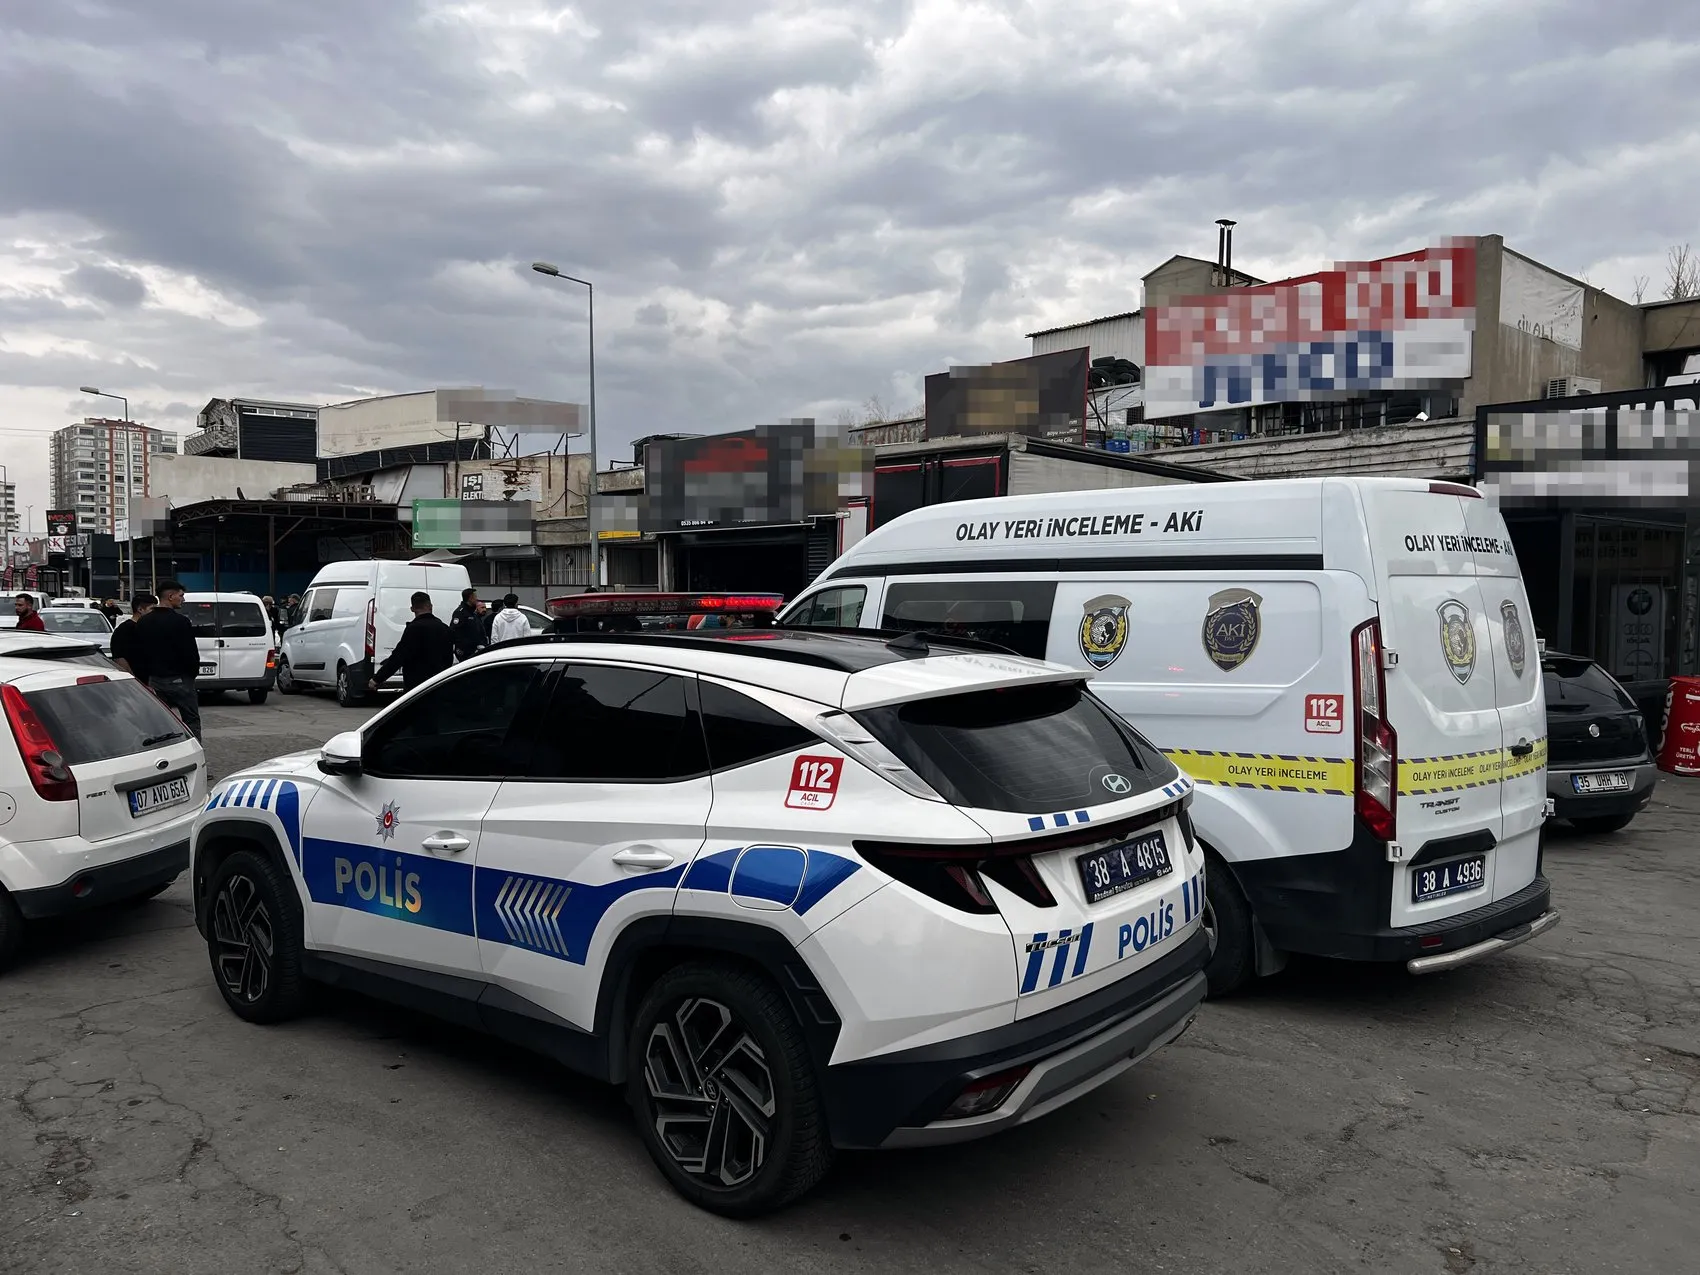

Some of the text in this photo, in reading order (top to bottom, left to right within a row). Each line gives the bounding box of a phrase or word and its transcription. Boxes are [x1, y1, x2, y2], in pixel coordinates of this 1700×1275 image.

[956, 521, 1000, 541] OLAY
[1004, 519, 1043, 538] YERİ
[1046, 513, 1144, 538] İNCELEME
[1163, 510, 1203, 533] AKİ
[1404, 534, 1436, 552] OLAY
[1437, 534, 1460, 552] YERİ
[1460, 535, 1500, 554] İNCELEME
[1216, 621, 1246, 637] AKİ
[202, 666, 214, 674] 826
[1310, 698, 1338, 717] 112
[799, 761, 834, 789] 112
[1228, 765, 1328, 781] OLAY YERİ İNCELEME
[1412, 772, 1432, 782] OLAY
[1433, 769, 1447, 780] YERİ
[1447, 766, 1474, 777] İNCELEME
[1479, 762, 1492, 773] OLAY
[1578, 775, 1590, 788] 35
[1614, 773, 1626, 785] 78
[137, 790, 148, 808] 07
[169, 781, 186, 799] 654
[1420, 796, 1461, 809] TRANSIT
[1089, 838, 1165, 888] 38 A 4815
[334, 857, 422, 913] POLİS
[1422, 860, 1482, 893] 38 A 4936
[1117, 898, 1174, 960] POLİS
